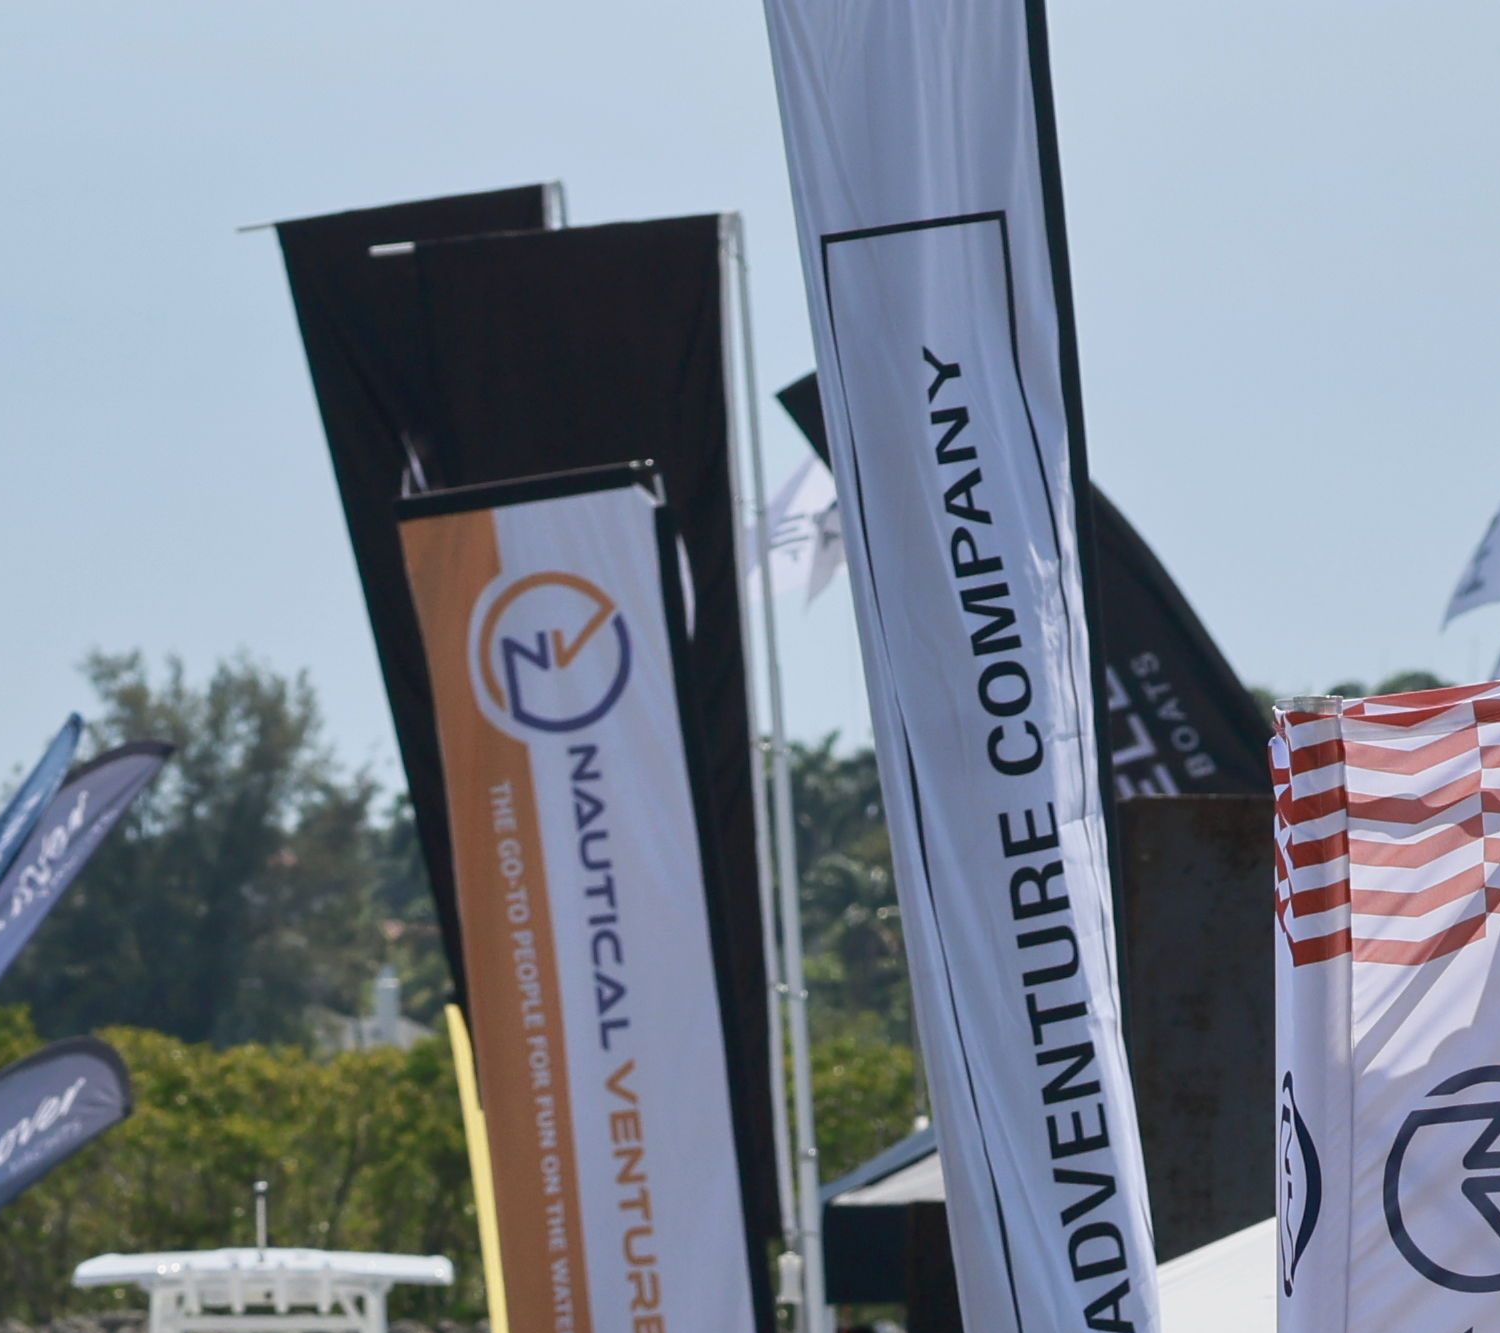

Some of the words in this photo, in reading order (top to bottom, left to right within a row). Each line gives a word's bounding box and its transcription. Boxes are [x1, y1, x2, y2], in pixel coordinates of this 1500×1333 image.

[921, 345, 1044, 777] COMPANY
[489, 782, 516, 833] THE
[497, 838, 531, 926] GO-TO
[566, 743, 632, 1051] NAUTICAL
[511, 931, 546, 1031] PEOPLE
[526, 1034, 552, 1090] FOR
[534, 1094, 557, 1151] FUN
[540, 1154, 563, 1198] ON
[545, 1200, 568, 1253] THE
